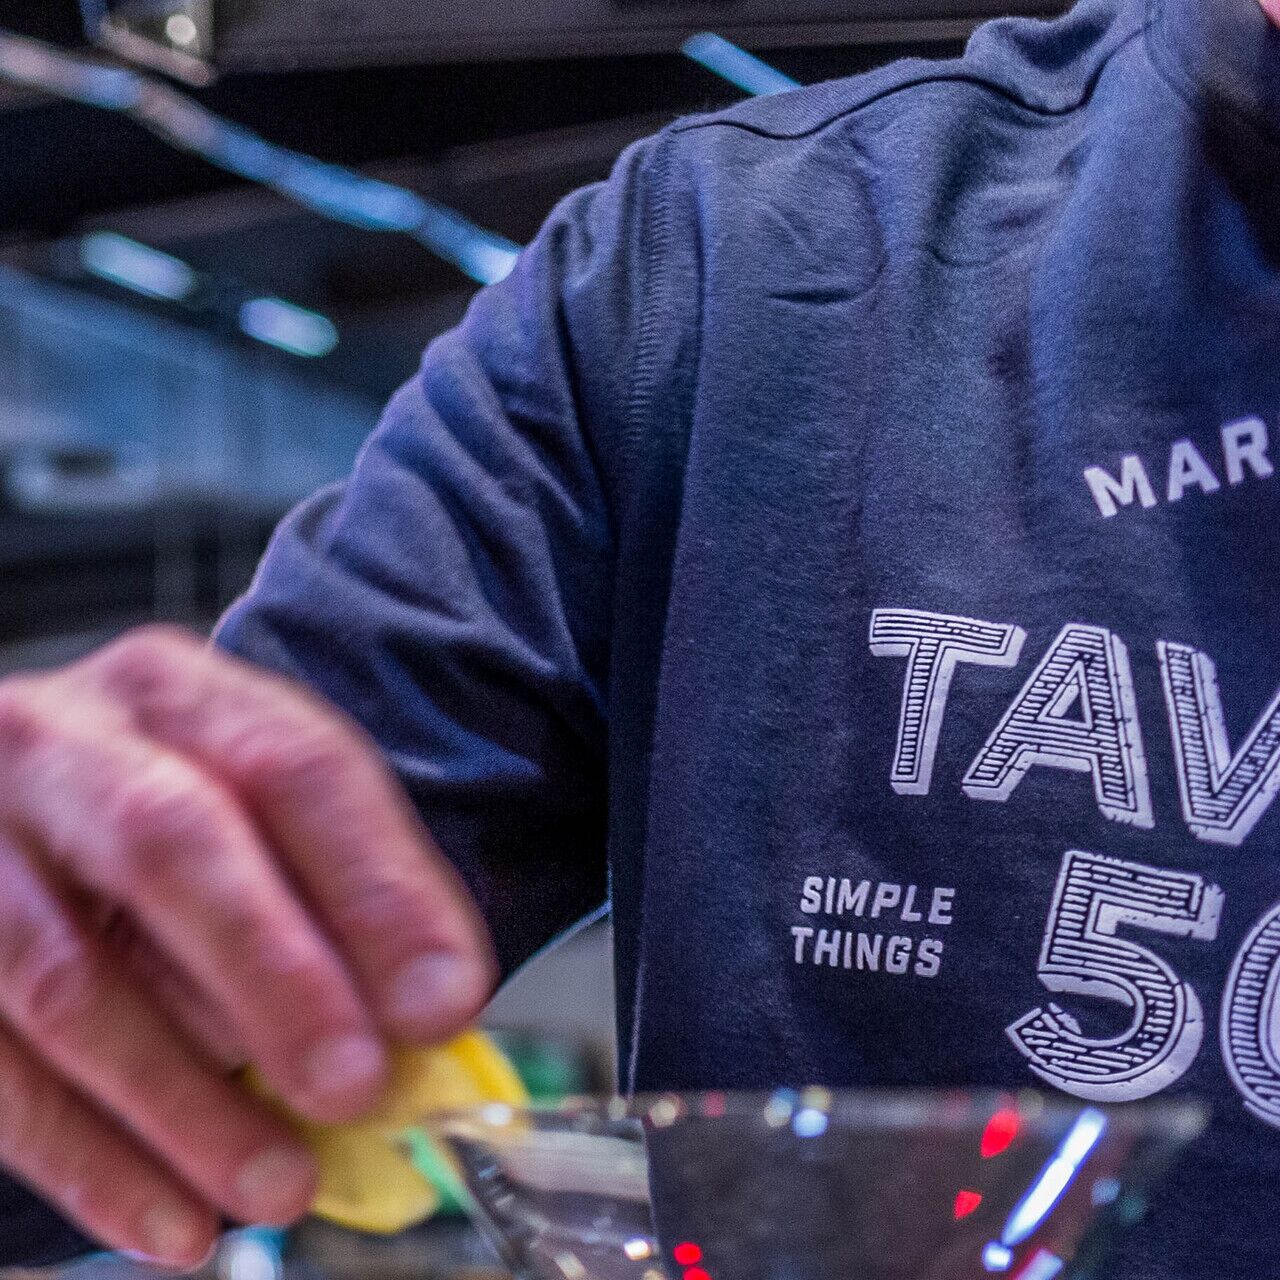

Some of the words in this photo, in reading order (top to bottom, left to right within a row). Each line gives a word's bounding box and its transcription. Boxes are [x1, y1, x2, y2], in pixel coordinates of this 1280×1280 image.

[1083, 415, 1274, 518] MAR
[868, 607, 1280, 846] TAV
[801, 876, 956, 926] SIMPLE
[790, 926, 945, 977] THINGS
